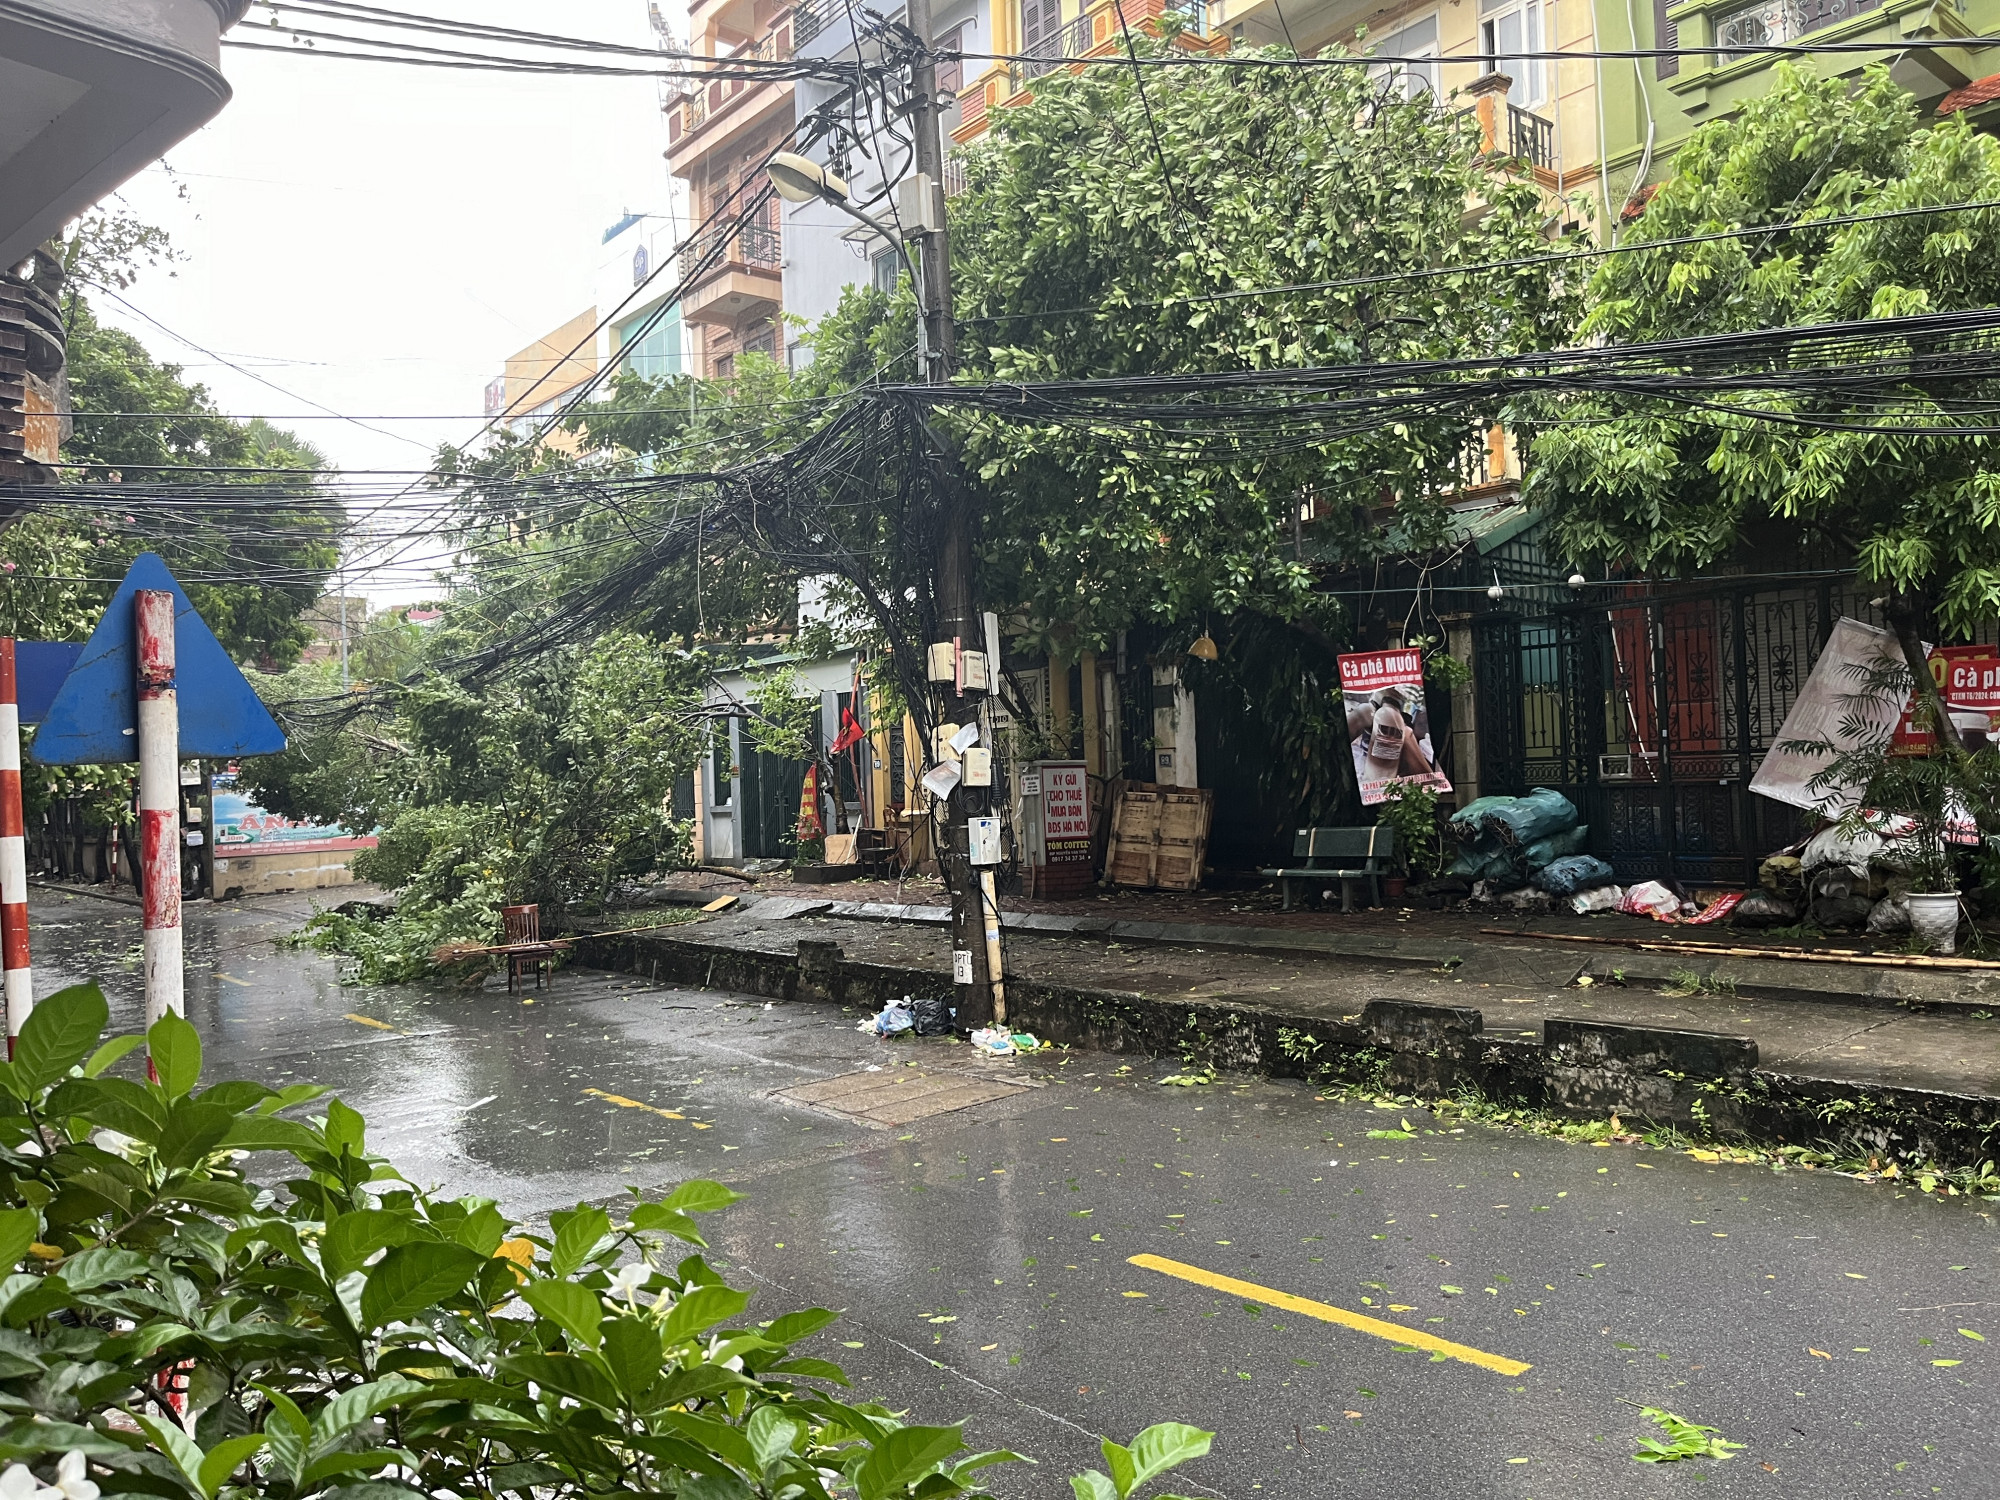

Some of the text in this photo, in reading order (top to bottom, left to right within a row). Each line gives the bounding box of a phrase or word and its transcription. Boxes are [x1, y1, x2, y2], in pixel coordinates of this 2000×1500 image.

[1342, 651, 1418, 678] Cà phê MUỐI
[1953, 667, 1977, 688] Cà
[1050, 790, 1064, 802] CHO
[1051, 805, 1066, 817] MUA
[1064, 840, 1088, 849] COFFEE
